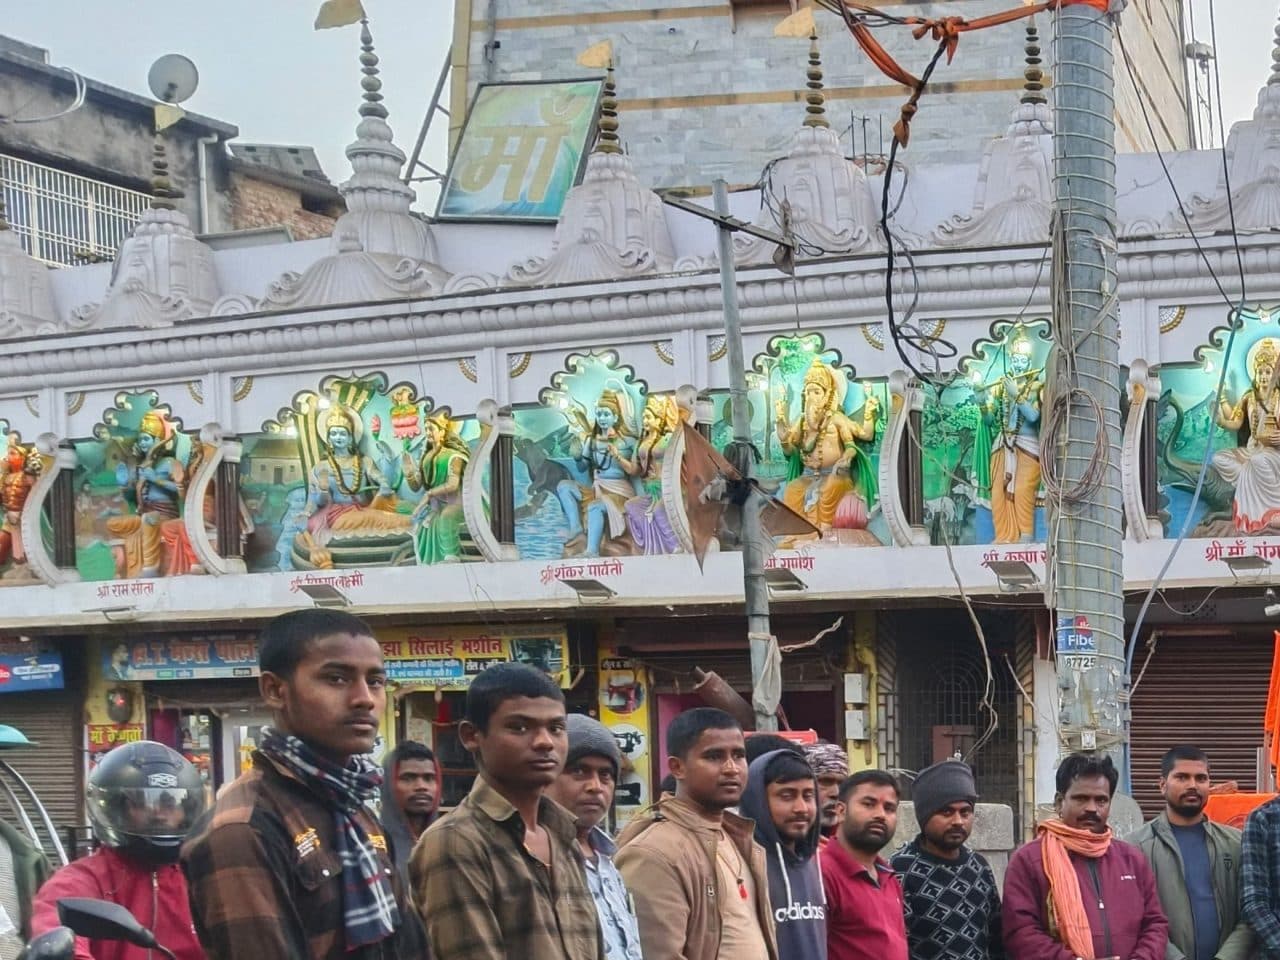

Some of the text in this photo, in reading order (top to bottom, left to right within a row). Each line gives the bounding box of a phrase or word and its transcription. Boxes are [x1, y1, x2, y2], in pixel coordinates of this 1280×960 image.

[461, 92, 588, 202] माँ
[1205, 540, 1223, 562] श्री
[408, 635, 454, 657] सिलाई
[462, 634, 503, 654] मशीन
[775, 901, 825, 922] adidas
